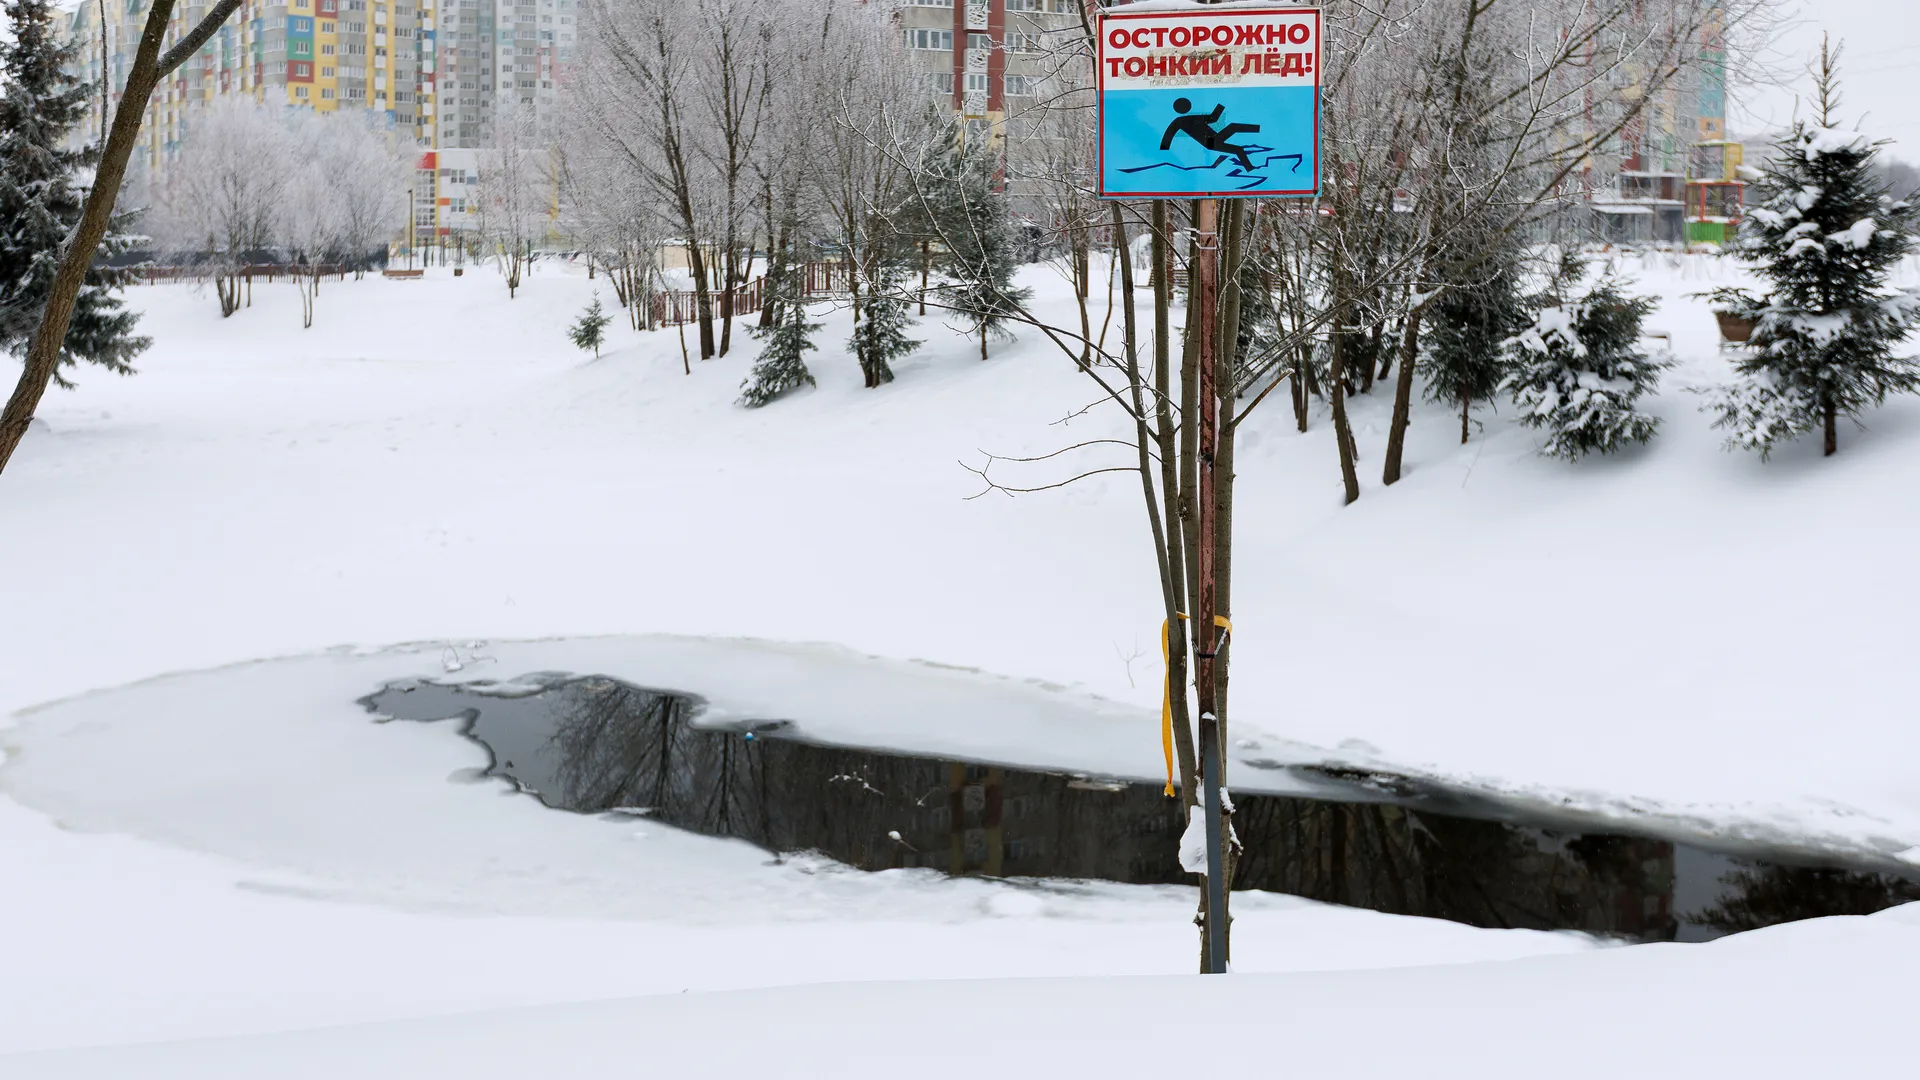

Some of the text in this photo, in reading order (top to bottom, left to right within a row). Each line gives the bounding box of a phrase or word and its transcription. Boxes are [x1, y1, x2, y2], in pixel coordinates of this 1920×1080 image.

[1109, 24, 1310, 49] ОСТОРОЖНО
[1106, 47, 1312, 77] ТОНКИЙ ЛЁД!
